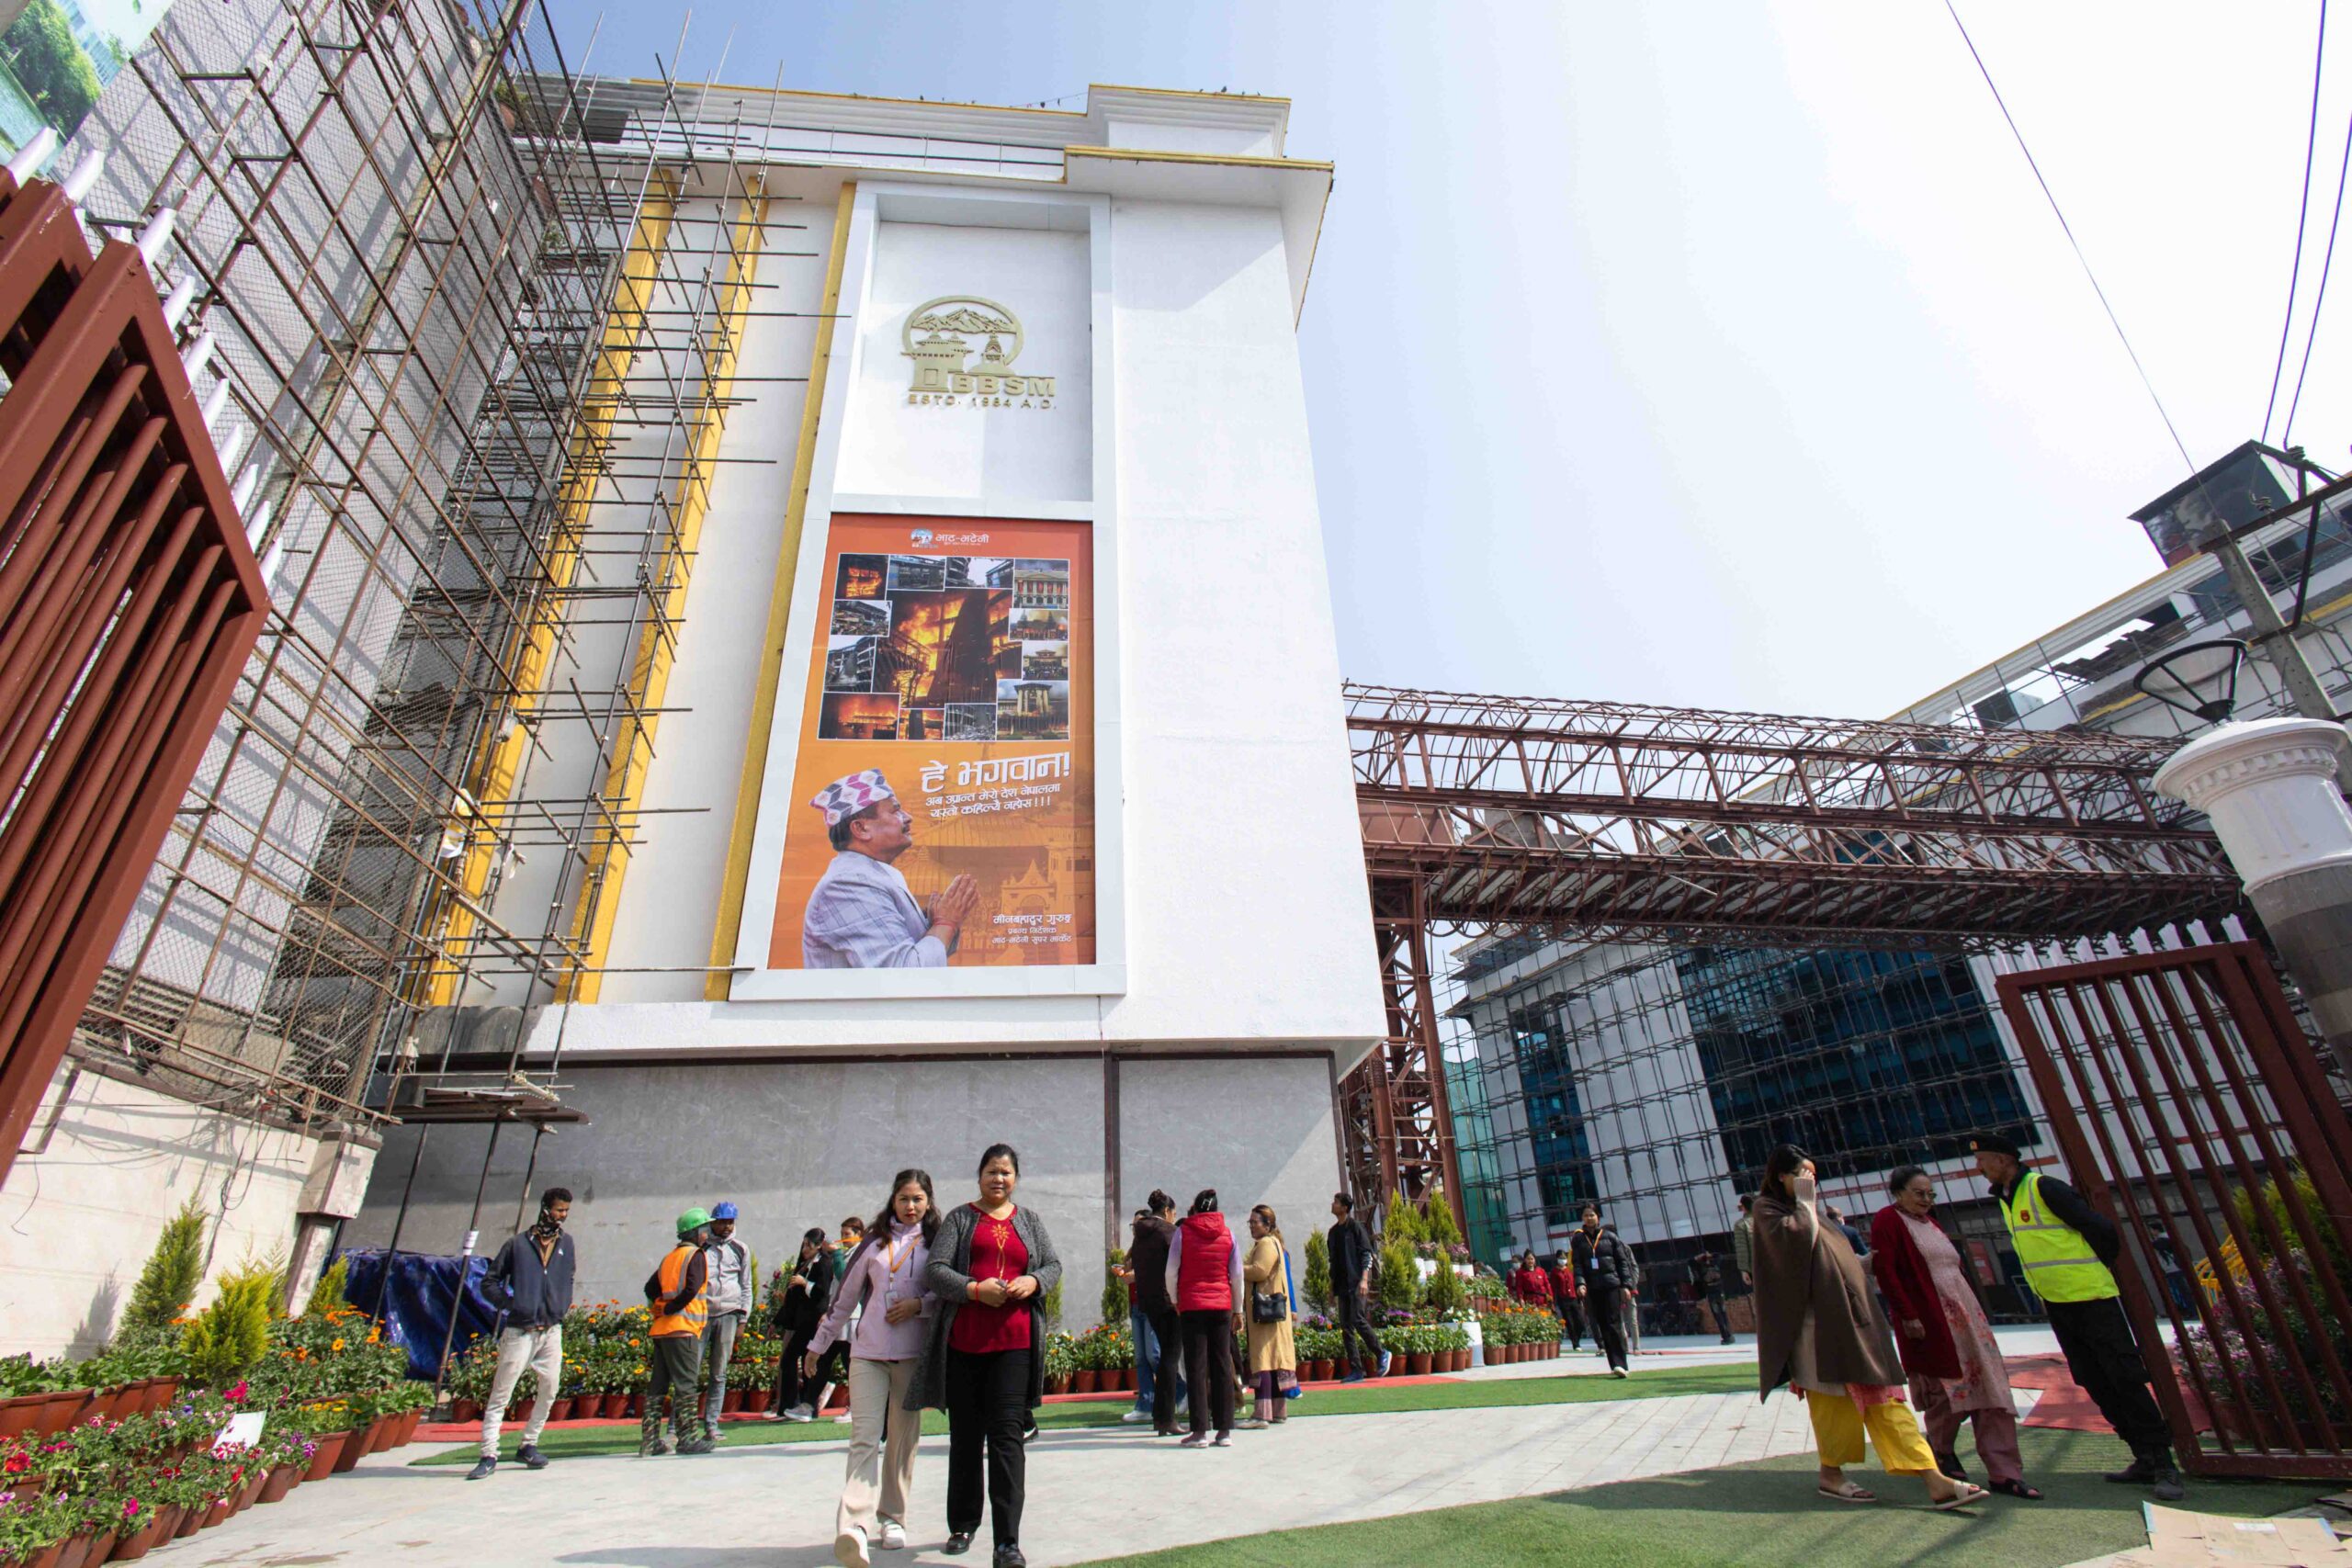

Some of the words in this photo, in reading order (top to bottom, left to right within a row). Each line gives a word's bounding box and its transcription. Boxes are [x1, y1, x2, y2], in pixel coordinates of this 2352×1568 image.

[952, 374, 1055, 397] BBSM
[920, 760, 949, 793] हे
[957, 751, 1070, 786] भगवान!
[925, 795, 944, 807] अब
[978, 788, 998, 801] मेरो
[1020, 783, 1061, 795] नेपालमा
